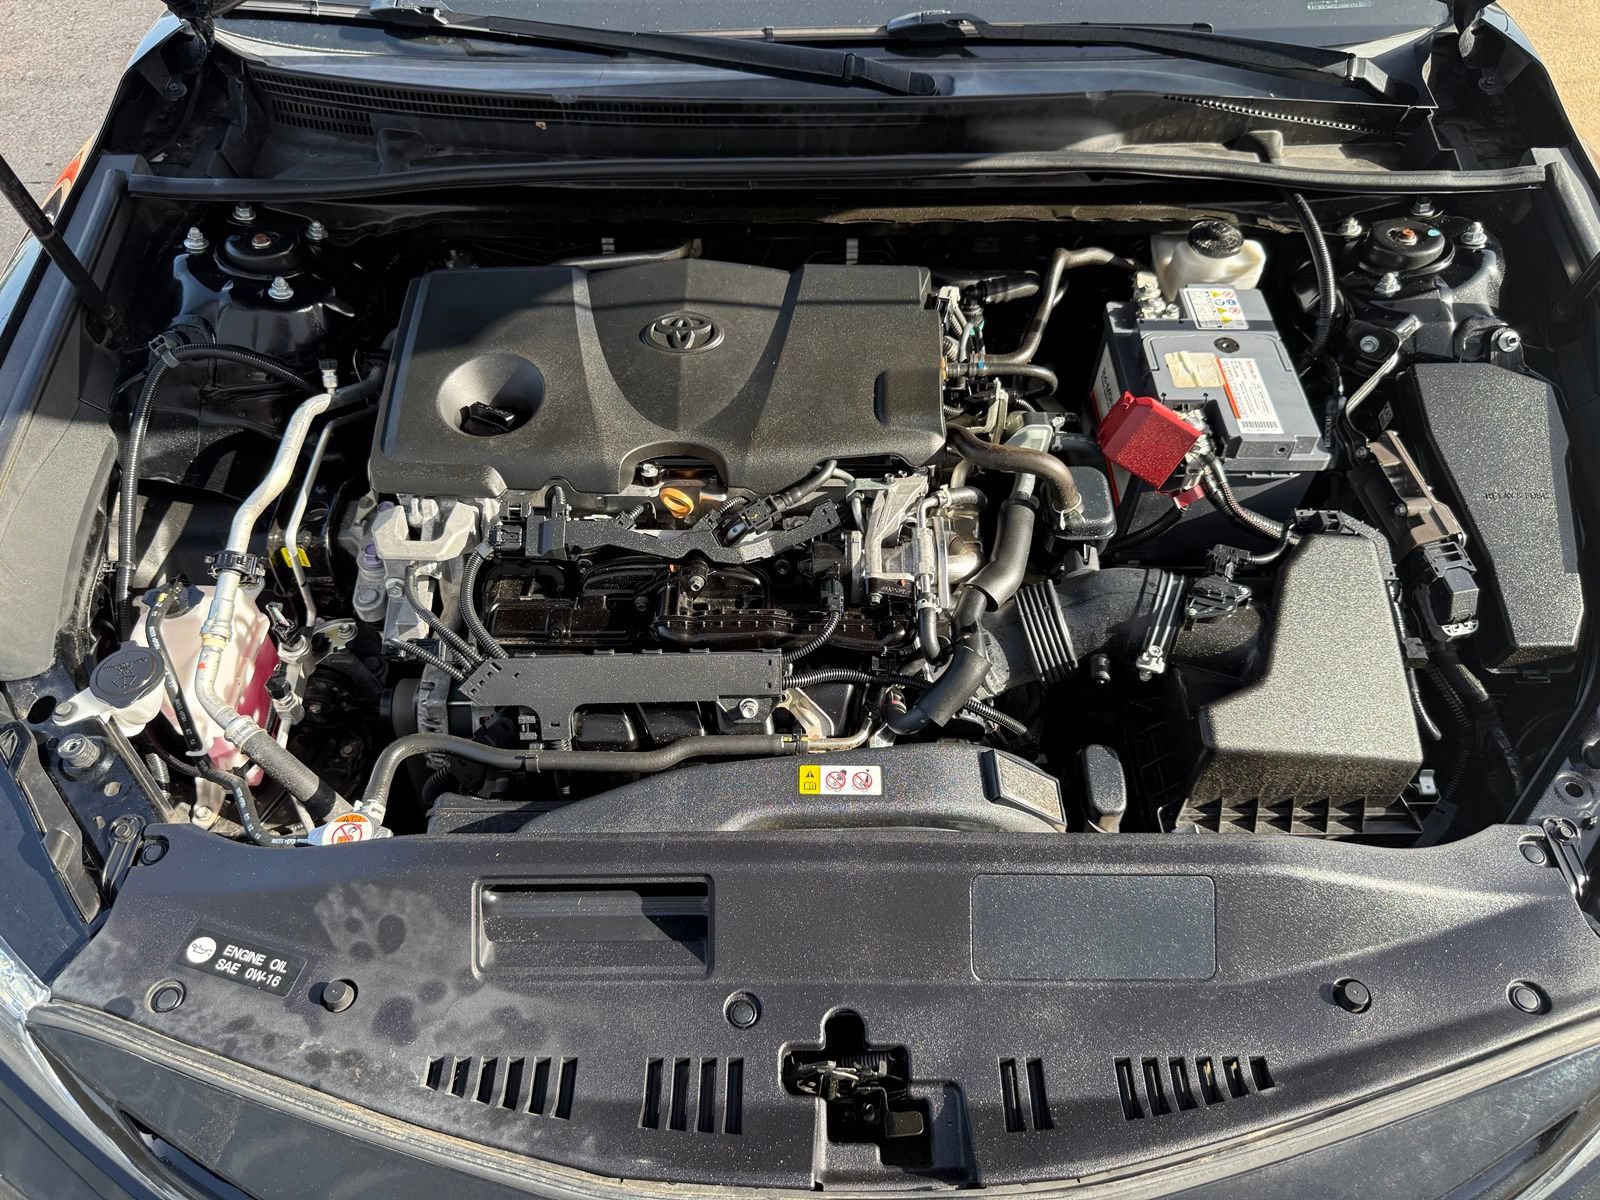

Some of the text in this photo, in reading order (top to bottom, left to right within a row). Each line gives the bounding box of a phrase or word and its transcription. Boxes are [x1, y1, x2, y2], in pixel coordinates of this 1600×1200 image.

[215, 958, 282, 987] SAE 0W-16
[222, 944, 288, 973] ENGINE OIL
